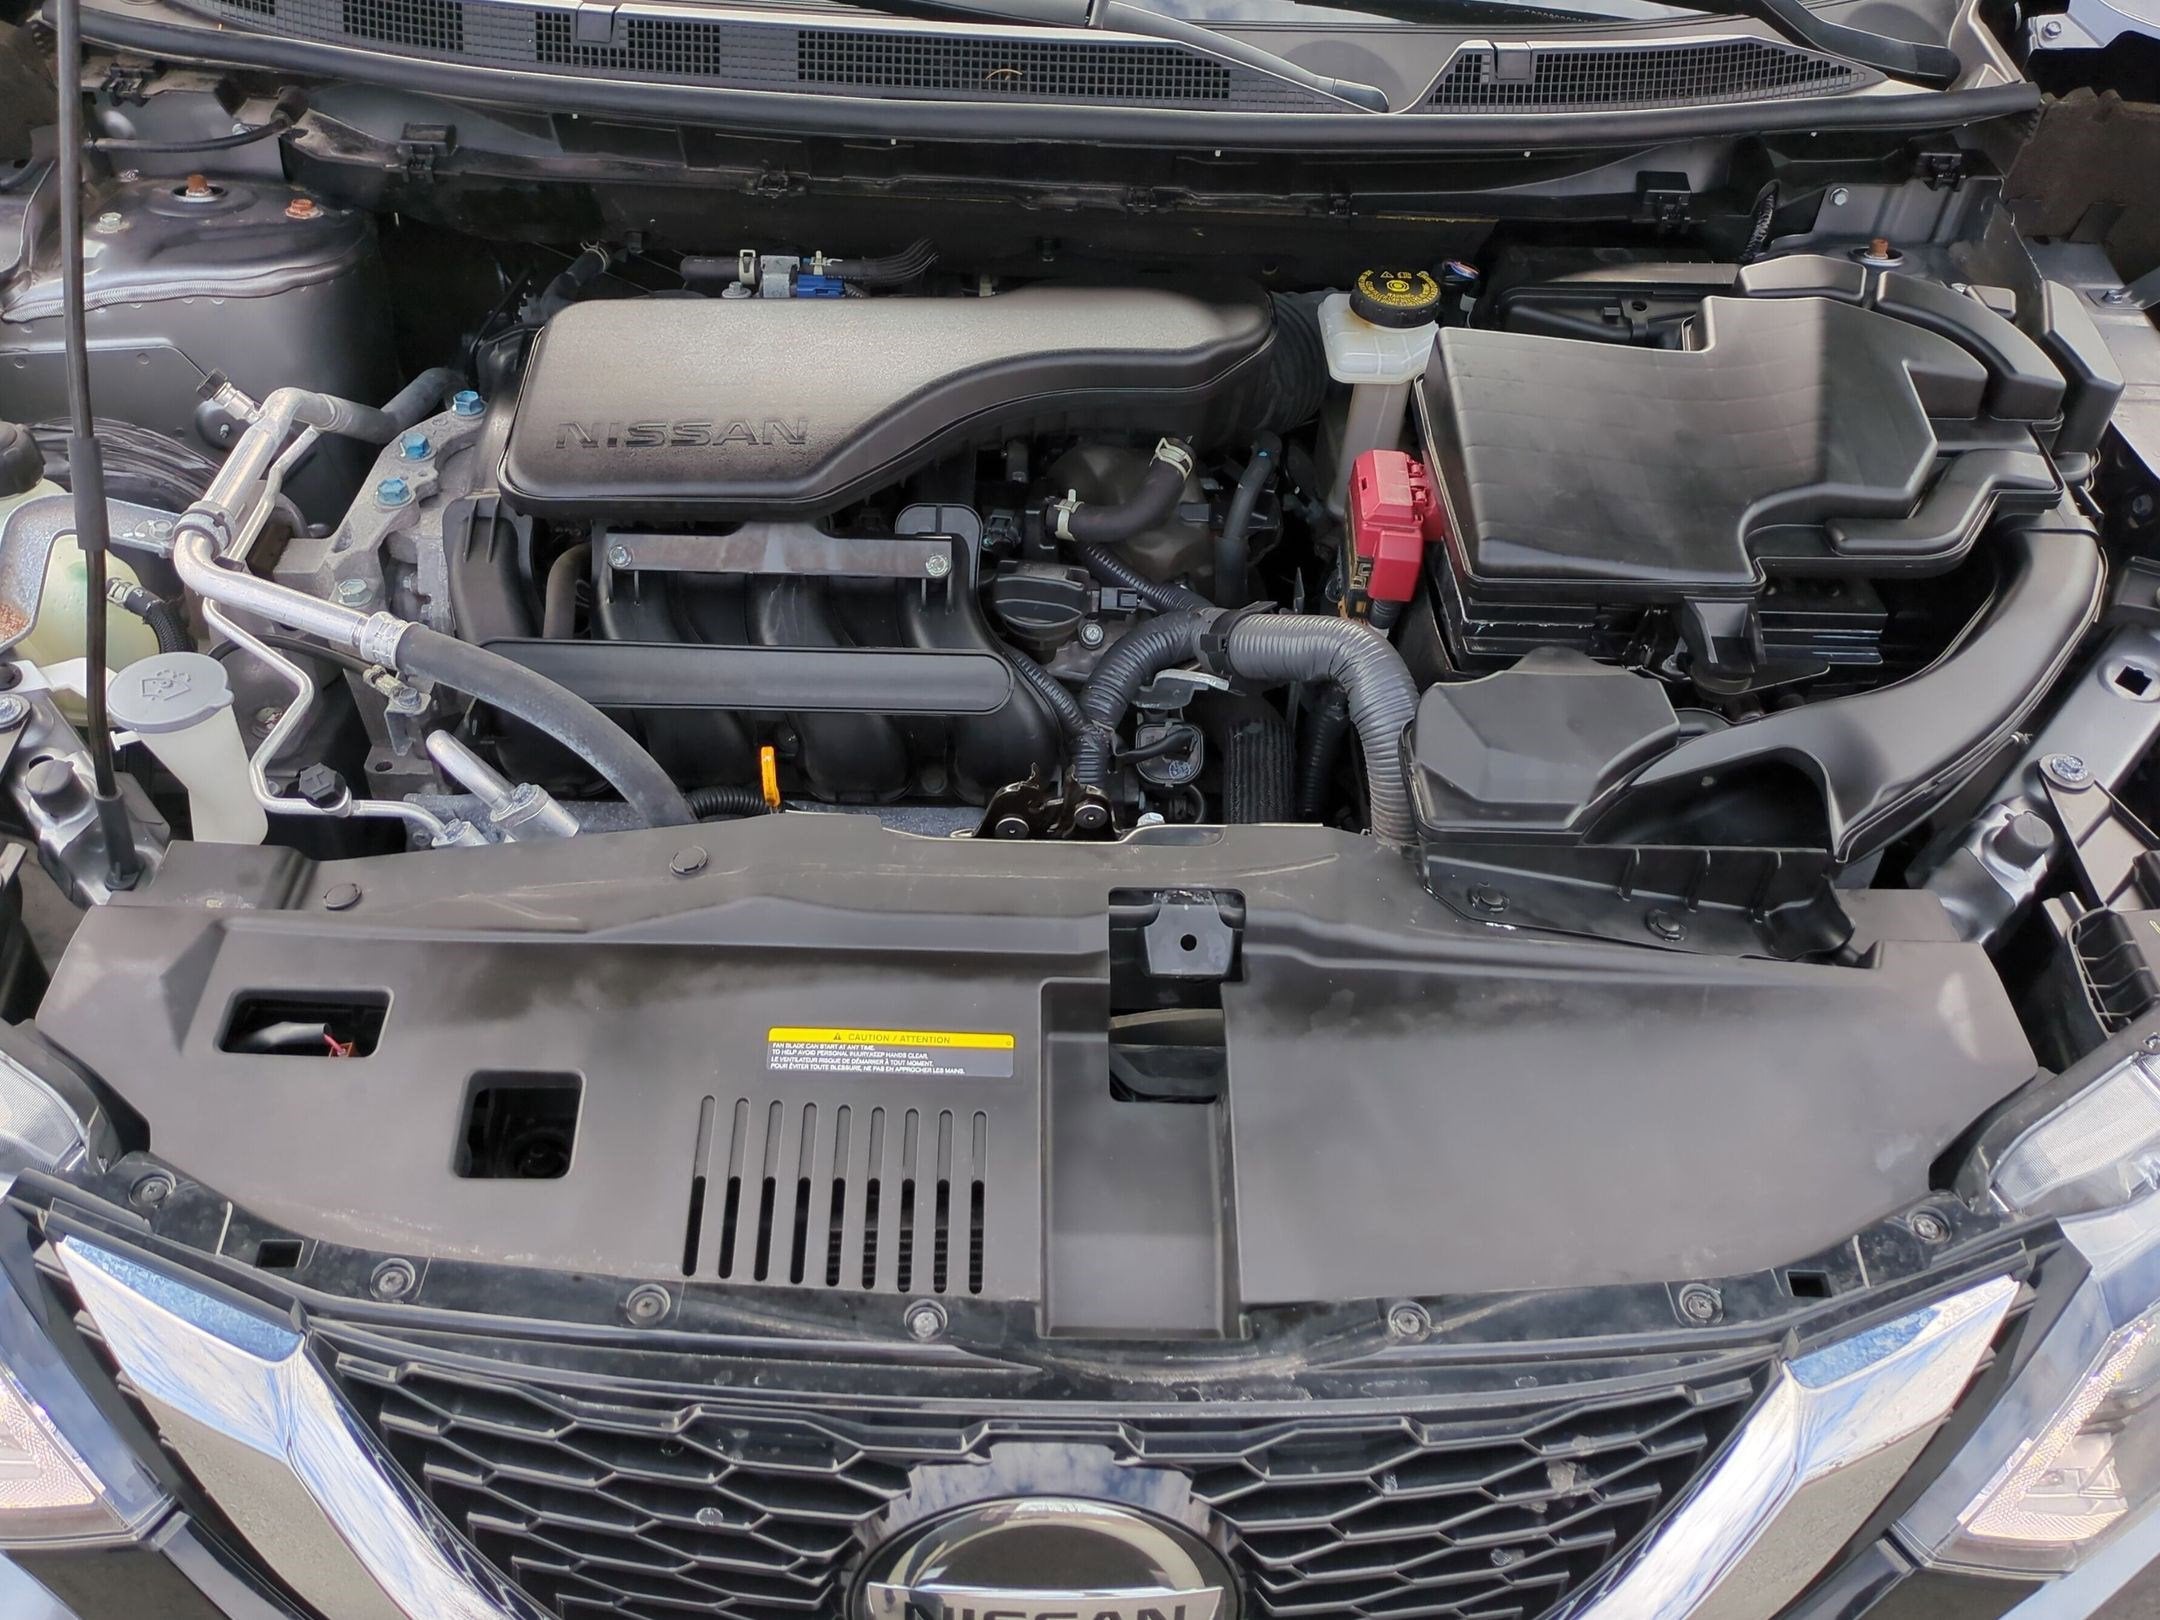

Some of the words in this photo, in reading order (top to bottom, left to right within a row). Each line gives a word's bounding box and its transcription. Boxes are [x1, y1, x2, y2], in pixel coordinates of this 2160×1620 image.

[555, 419, 809, 448] NISSAN
[848, 1033, 890, 1042] CAUTION
[900, 1034, 950, 1044] ATTENTION
